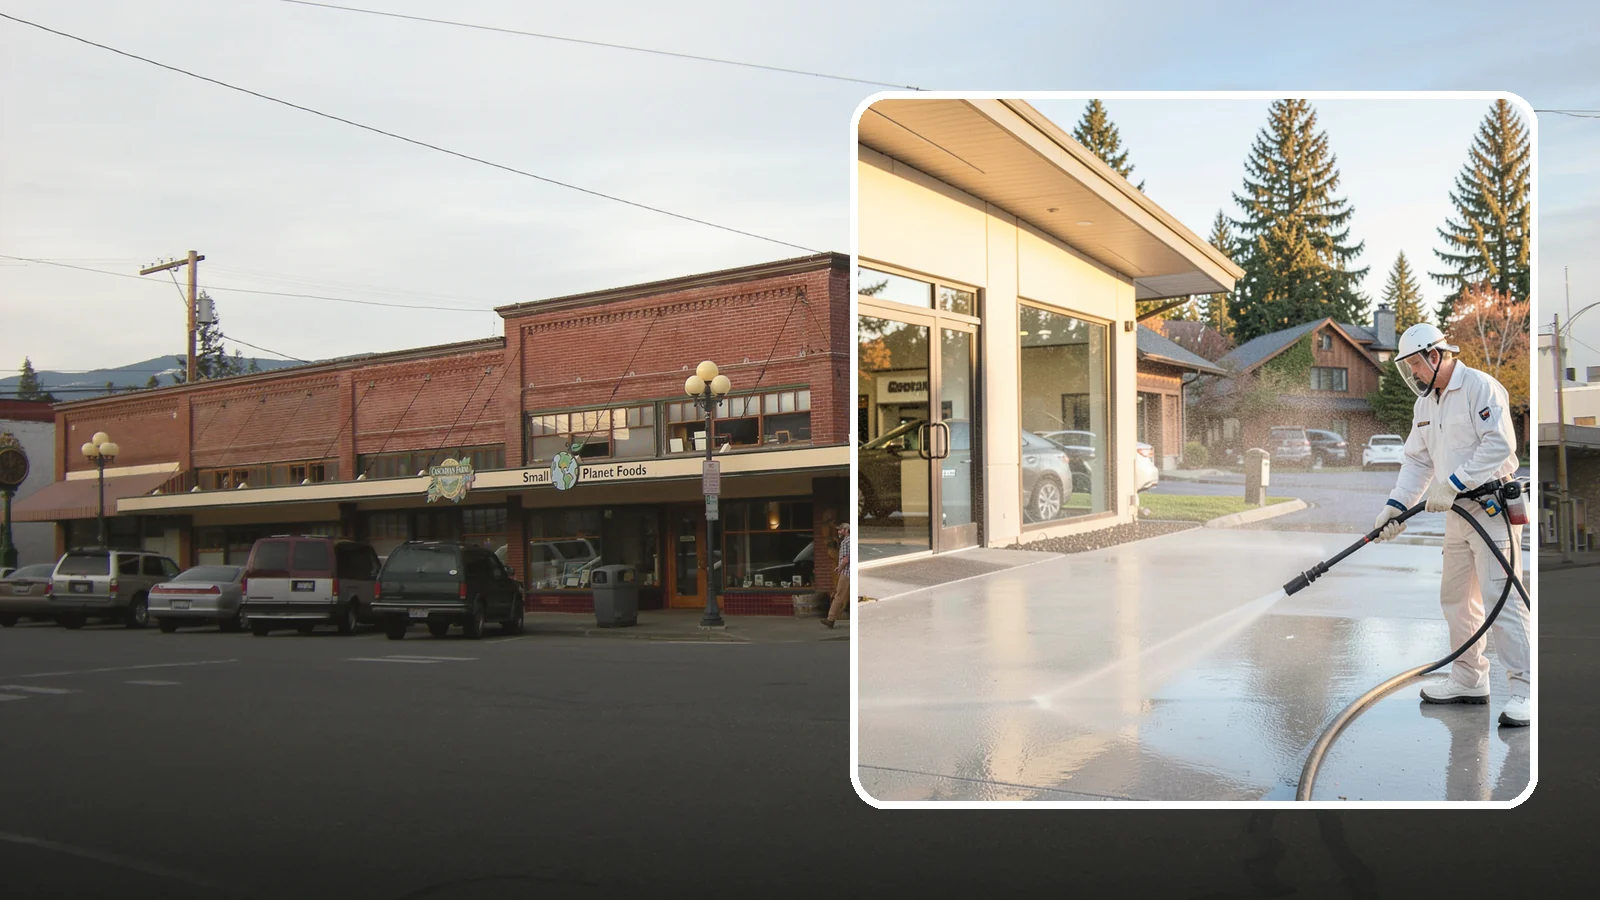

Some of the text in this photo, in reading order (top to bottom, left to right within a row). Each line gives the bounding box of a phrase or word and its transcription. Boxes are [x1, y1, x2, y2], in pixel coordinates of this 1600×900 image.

[523, 464, 647, 483] Small Planet Foods
